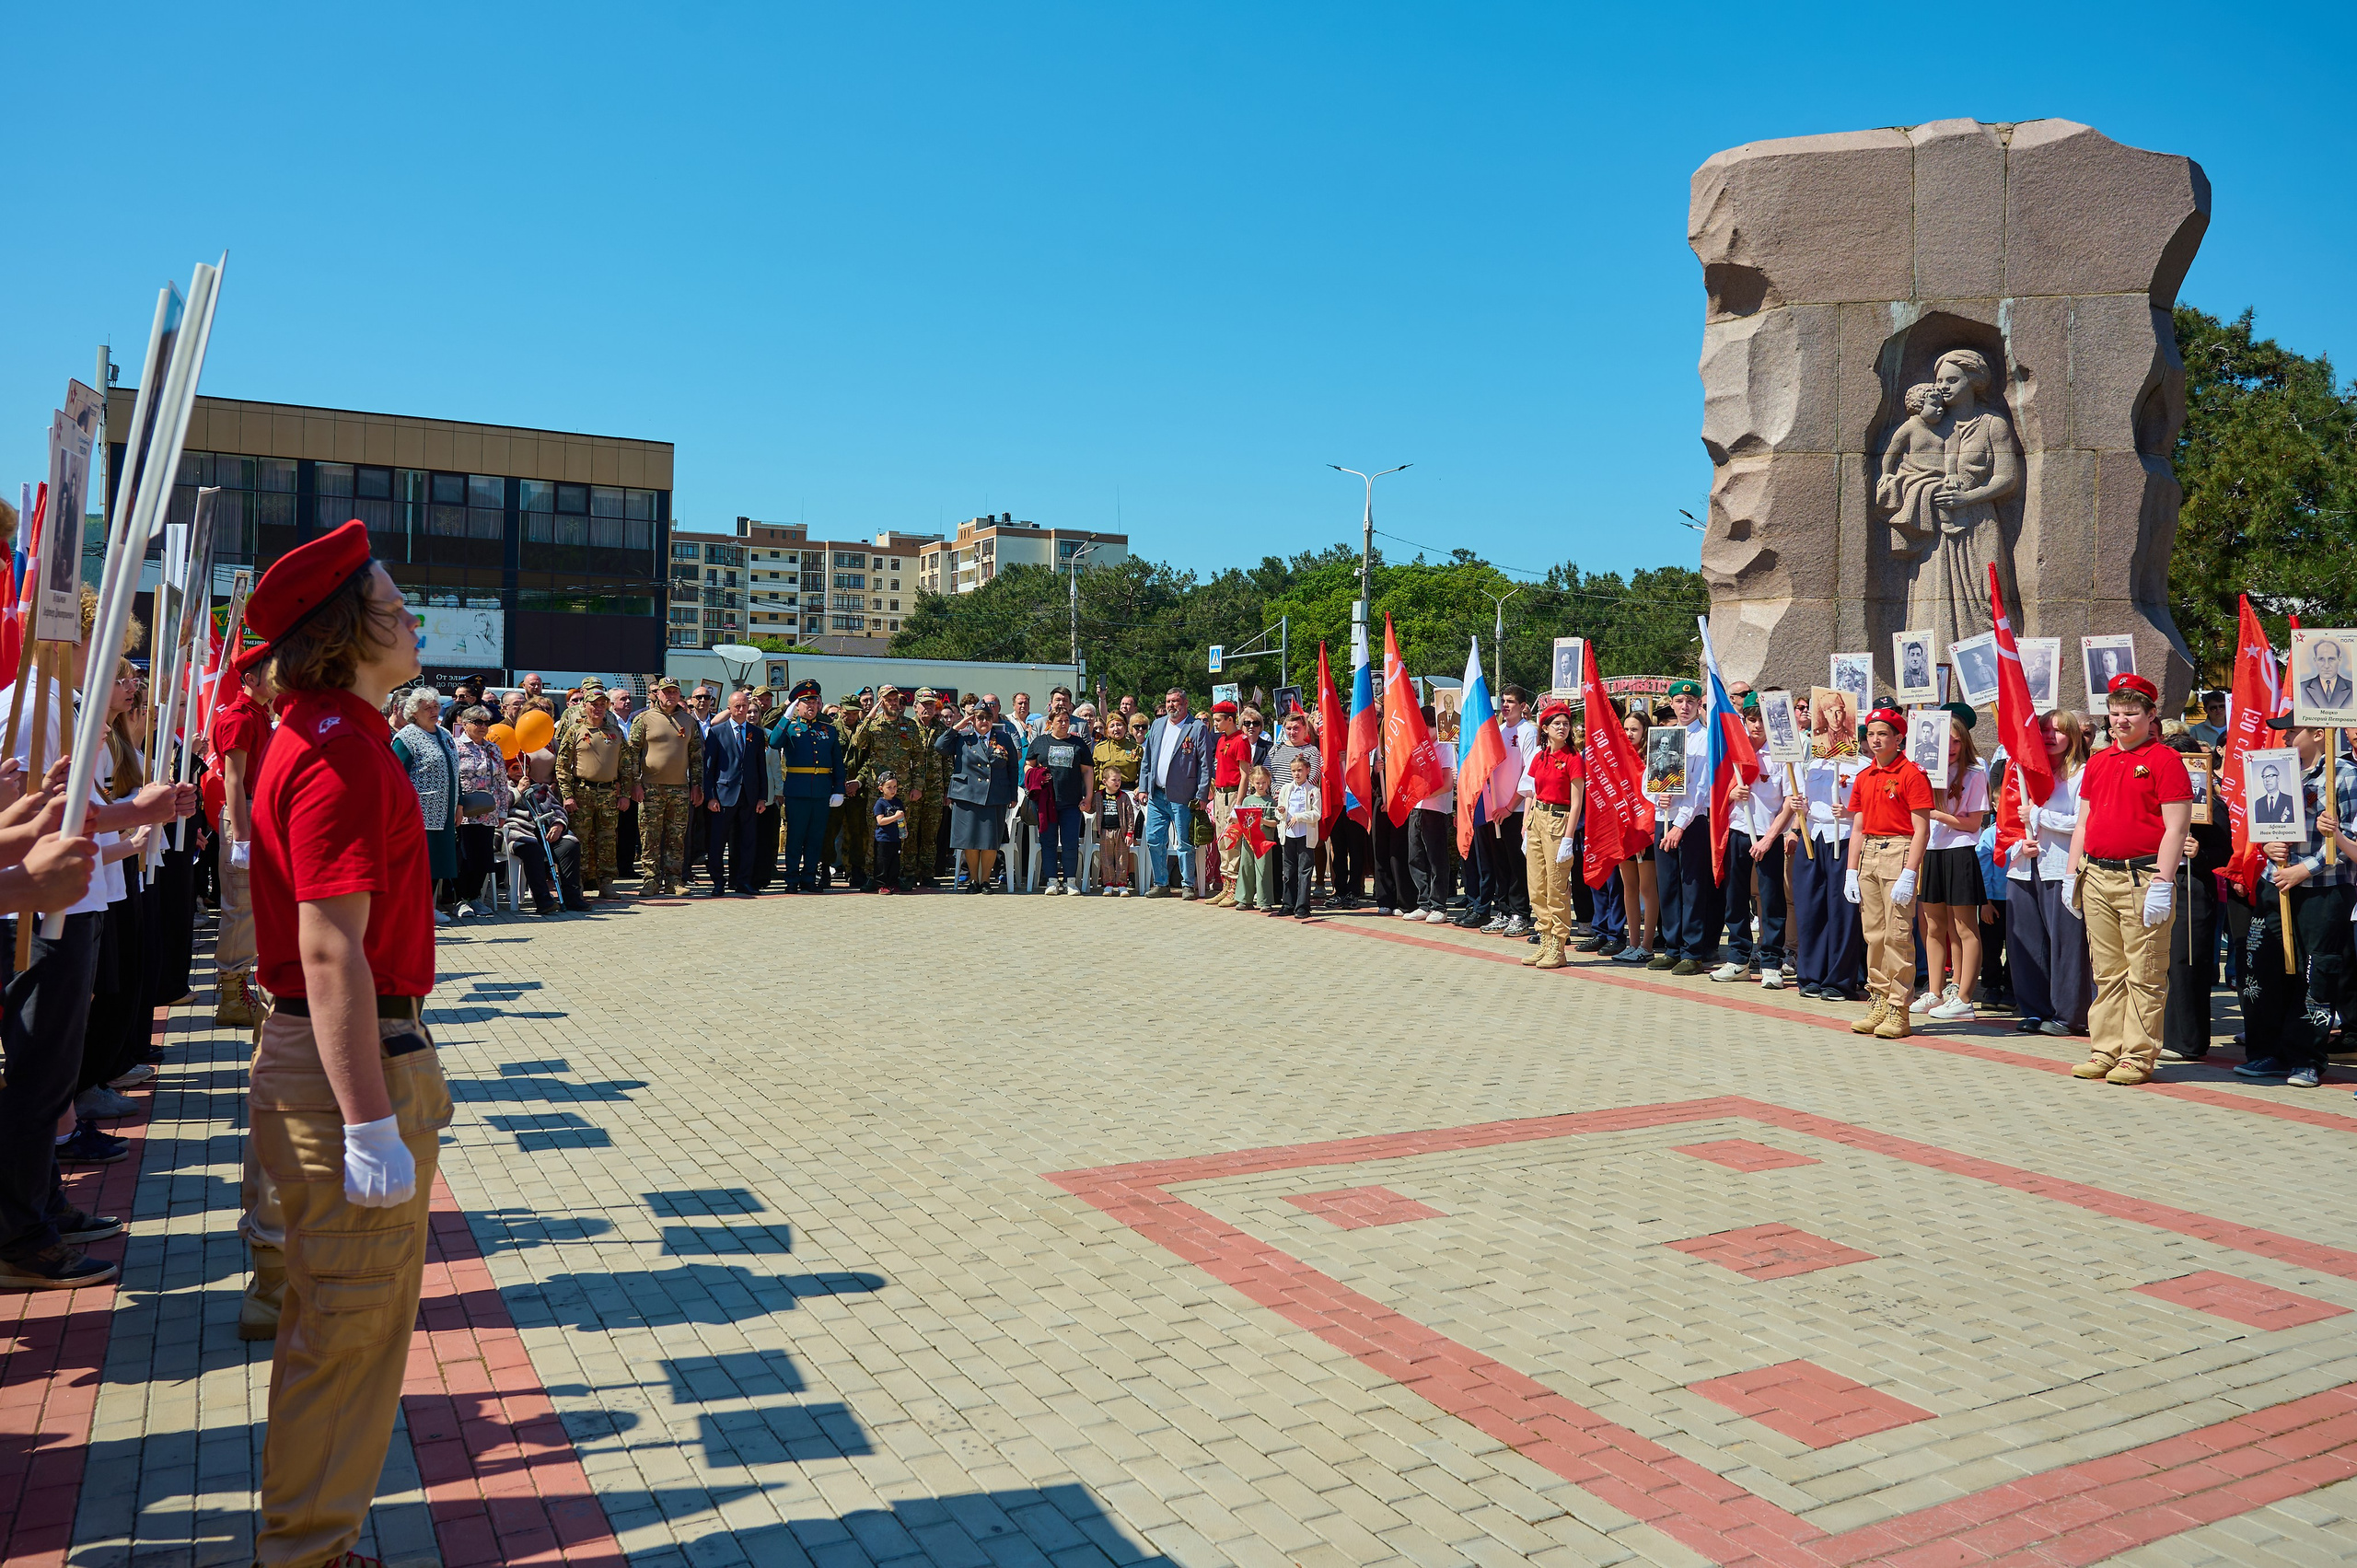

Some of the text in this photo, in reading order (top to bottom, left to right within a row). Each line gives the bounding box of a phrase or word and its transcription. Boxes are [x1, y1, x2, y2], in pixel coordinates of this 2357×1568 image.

[1585, 744, 1617, 798] КУТУЗОВА
[1591, 728, 1646, 818] 150 СТР. ОРДЕНА
[1590, 789, 1607, 813] ДИВ.
[1613, 797, 1629, 811] II
[1619, 812, 1631, 828] СТ.
